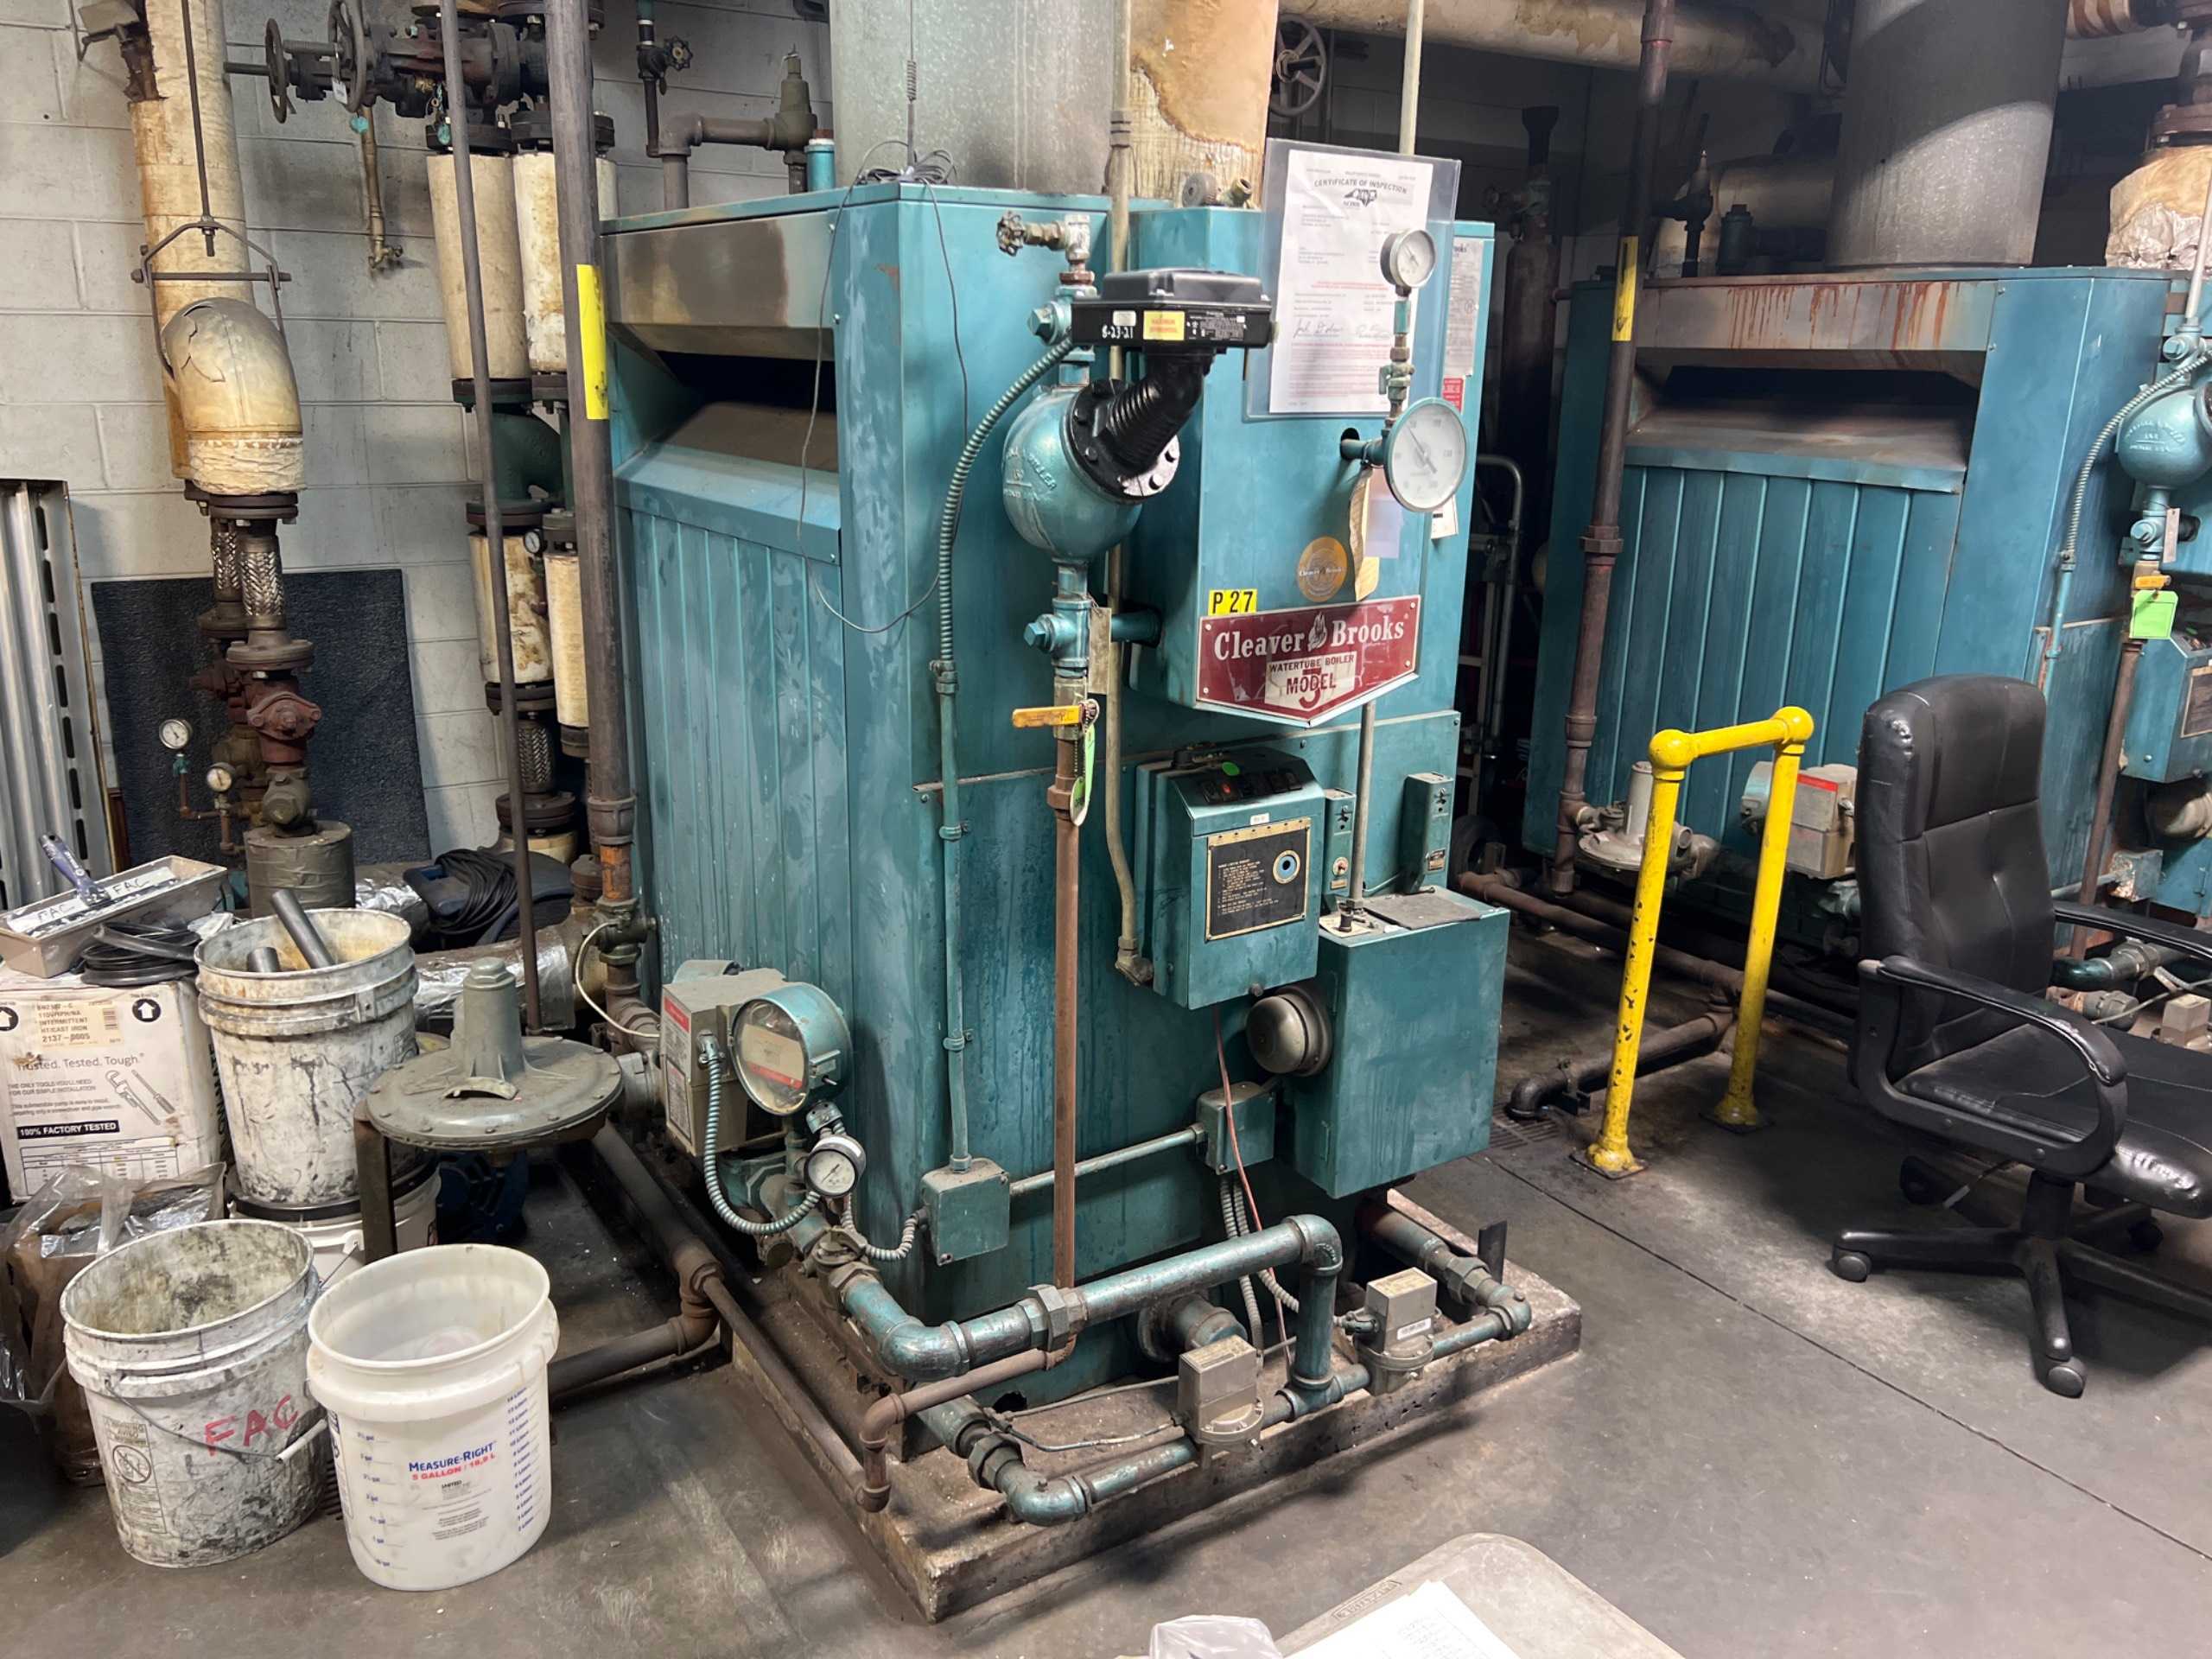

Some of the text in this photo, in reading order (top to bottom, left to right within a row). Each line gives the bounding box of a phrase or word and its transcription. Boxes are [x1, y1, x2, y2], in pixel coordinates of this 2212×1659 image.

[1314, 178, 1357, 188] CERTIFICATE
[1370, 181, 1407, 194] INSPECTION
[1212, 590, 1253, 614] P 27
[1214, 615, 1404, 661] Cleaver Brooks
[1269, 654, 1355, 673] WATERTUBE BOILER
[1286, 672, 1337, 696] MODEL
[64, 1057, 103, 1068] Tested.
[20, 1122, 117, 1136] 100% FACTORY TESTED
[205, 1394, 299, 1457] FAC
[409, 1442, 493, 1472] MEASURE-RIGHT
[421, 1466, 461, 1480] GALLON
